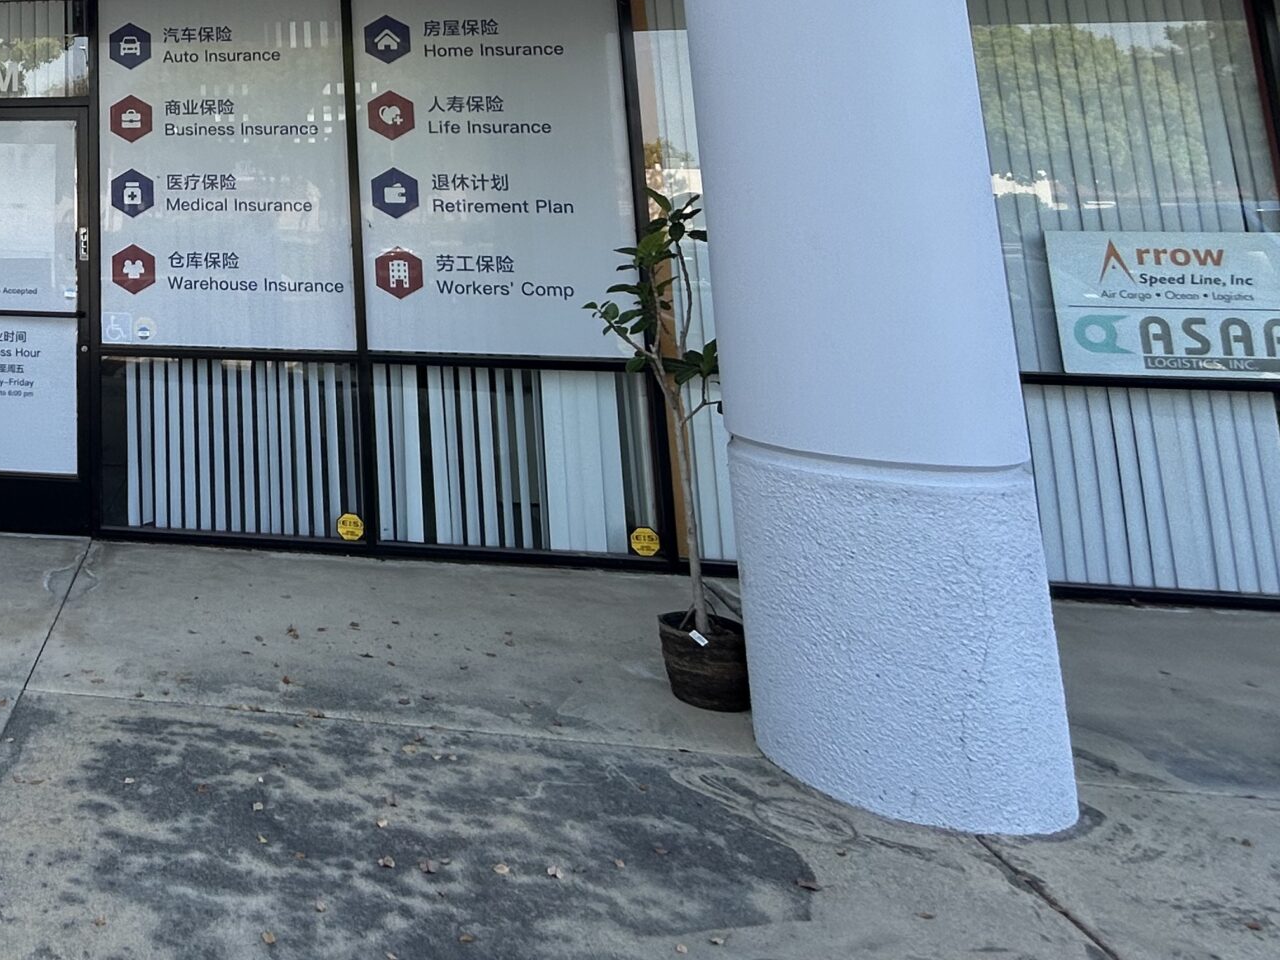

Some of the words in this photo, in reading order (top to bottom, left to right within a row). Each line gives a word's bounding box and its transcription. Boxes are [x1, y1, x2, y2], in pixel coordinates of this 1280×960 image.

[163, 26, 232, 43] 汽车保险
[423, 19, 499, 38] 房屋保险
[163, 49, 198, 64] Auto
[204, 49, 281, 64] Insurance
[424, 44, 474, 58] Home
[480, 44, 564, 57] Insurance
[164, 99, 234, 117] 商业保险
[428, 96, 504, 114] 人寿保险
[164, 122, 235, 137] Business
[240, 121, 318, 137] Insurance
[428, 120, 461, 135] Life
[467, 120, 552, 135] Insurance
[166, 174, 237, 191] 医疗保险
[431, 174, 509, 192] 退休计划
[166, 198, 228, 212] Medical
[233, 198, 313, 213] Insurance
[433, 198, 530, 214] Retirement
[536, 198, 574, 215] Plan
[168, 251, 239, 270] 仓库保险
[436, 255, 514, 274] 劳工保险
[167, 276, 258, 292] Warehouse
[264, 277, 344, 294] Insurance
[1139, 273, 1185, 286] Speed
[1191, 274, 1226, 286] Line,
[1231, 275, 1254, 286] Inc
[3, 287, 38, 295] Accepted
[521, 282, 575, 299] Comp
[1101, 290, 1116, 299] Air
[1119, 290, 1152, 302] Cargo
[1165, 291, 1200, 300] Ocean
[1212, 292, 1254, 303] Logistics
[15, 348, 41, 358] Hour
